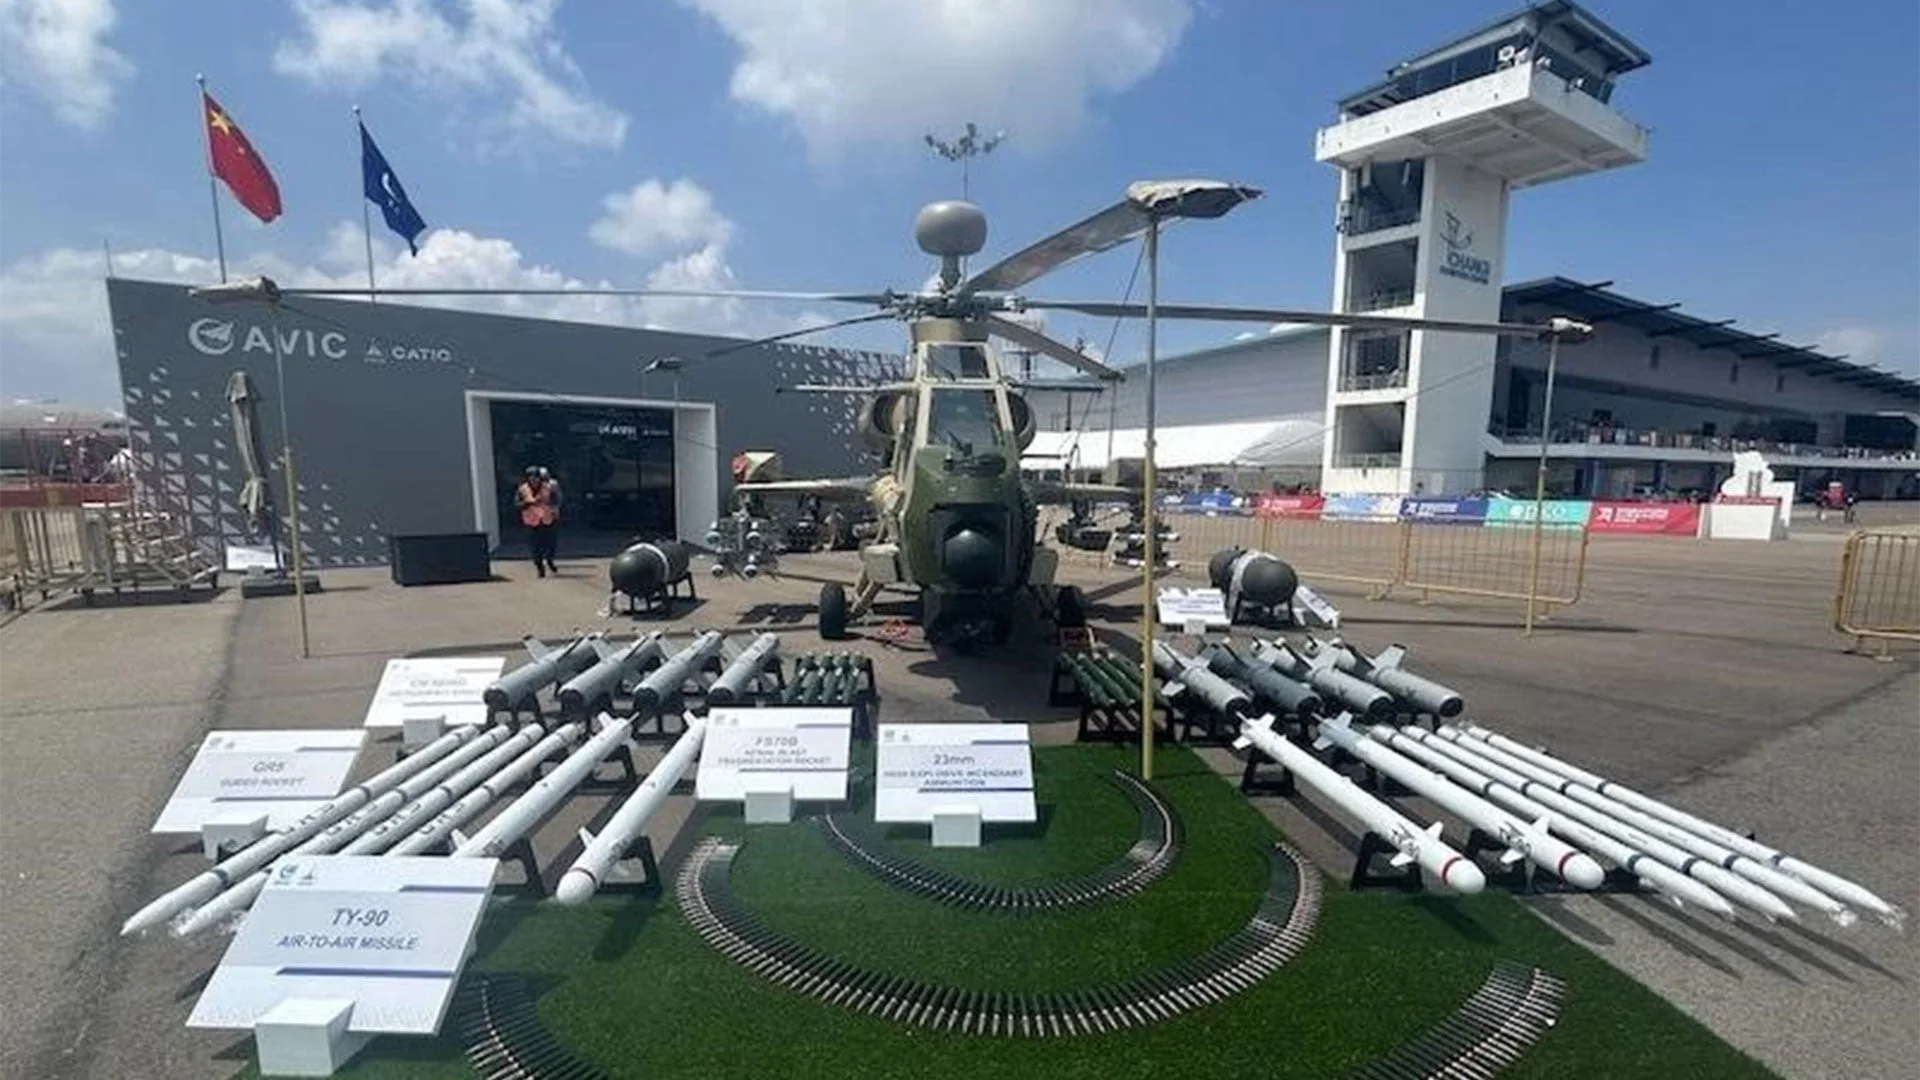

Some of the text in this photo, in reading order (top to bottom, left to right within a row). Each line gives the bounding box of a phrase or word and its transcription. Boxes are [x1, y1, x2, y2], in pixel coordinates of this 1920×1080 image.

[242, 326, 347, 359] AVIC
[391, 346, 452, 362] CATIC
[934, 755, 975, 765] 23mm
[331, 908, 389, 927] TY-90
[277, 934, 419, 950] AIR-TO-AIR MISSILE
